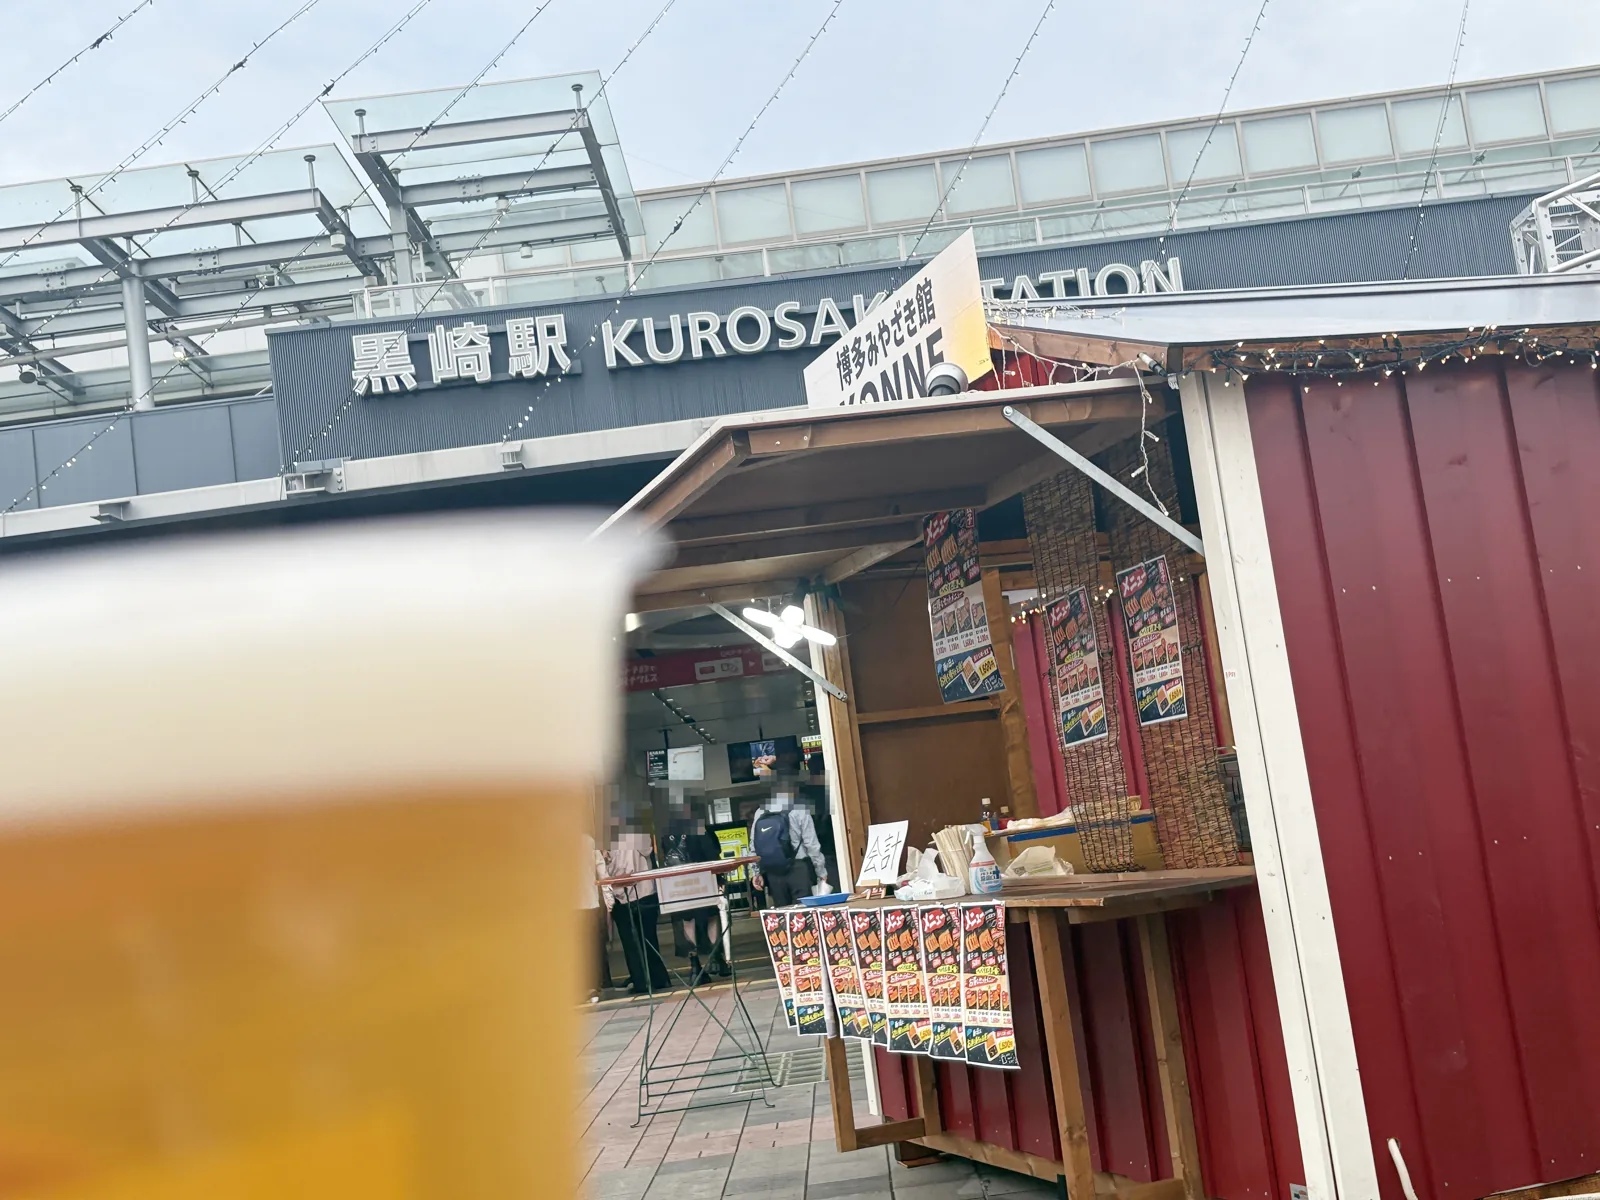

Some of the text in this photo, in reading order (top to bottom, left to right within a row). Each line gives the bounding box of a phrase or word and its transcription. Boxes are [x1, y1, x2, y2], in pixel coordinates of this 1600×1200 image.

[352, 257, 1184, 396] 黒崎駅 KUROSAK TATION
[836, 277, 936, 391] 博多みやざき館
[926, 514, 950, 547] メニュー
[1122, 572, 1146, 598] メニュー
[1050, 600, 1070, 628] メニュー
[864, 831, 902, 872] 会計
